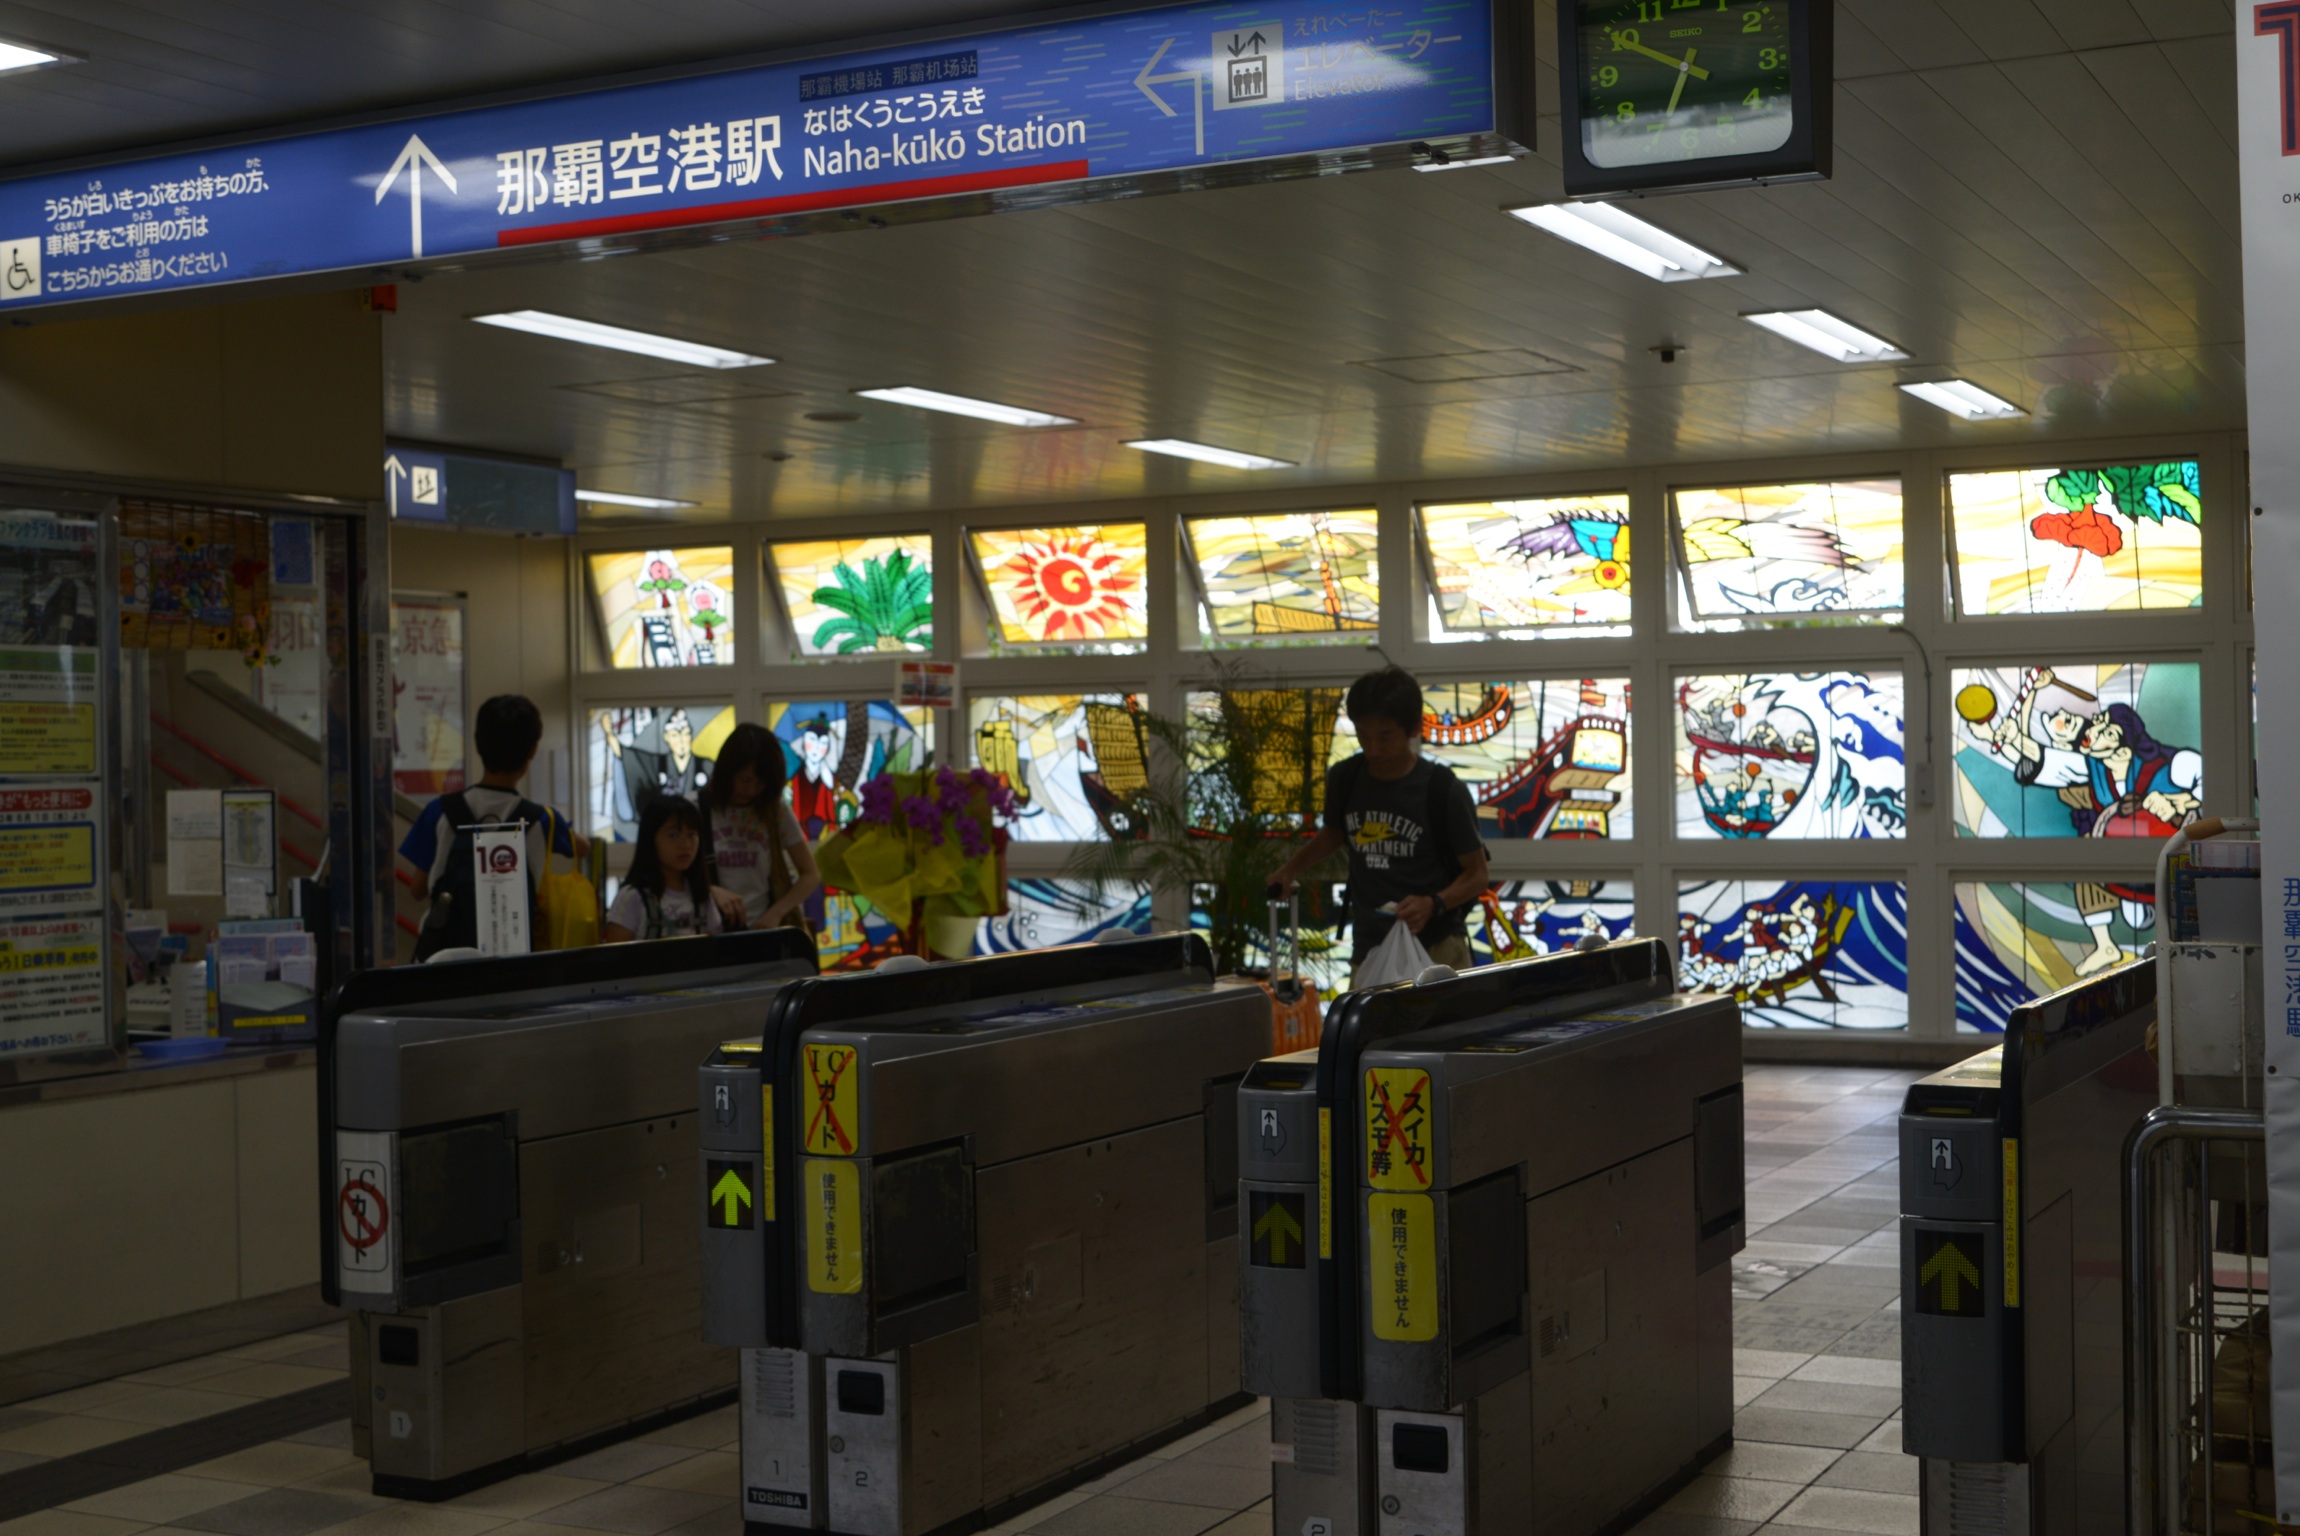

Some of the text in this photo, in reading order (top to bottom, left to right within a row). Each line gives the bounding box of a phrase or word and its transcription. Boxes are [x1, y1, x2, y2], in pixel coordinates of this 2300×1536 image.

[1294, 9, 1403, 37] えれべーたー
[1638, 0, 1664, 23] 11
[1742, 11, 1762, 33] 2
[1611, 28, 1640, 51] 10
[1669, 27, 1703, 39] SEIKO
[1294, 29, 1462, 71] エレベーター
[1759, 48, 1778, 70] 3
[1294, 73, 1385, 101] Elevator
[1599, 65, 1618, 87] 9
[803, 86, 986, 136] なはくうこうえき
[1742, 87, 1763, 110] 4
[1616, 101, 1636, 123] 8
[1647, 124, 1665, 145] 7
[1716, 116, 1736, 137] 5
[803, 115, 1086, 178] Naha-kūkō Station
[496, 115, 783, 216] 那覇空港駅
[44, 169, 270, 222] うらが白いきっぷをお持ちの方、
[45, 214, 209, 258] 車椅子をご利用の方は
[46, 250, 229, 293] こちらからお通りください
[1345, 811, 1362, 832] HE
[811, 1049, 846, 1074] IC
[819, 1079, 836, 1149] カード
[1370, 1080, 1392, 1177] パスモ等
[1404, 1089, 1425, 1166] スイカ
[345, 1167, 376, 1193] IC
[352, 1194, 367, 1265] カード
[822, 1172, 838, 1282] 使用できません
[1391, 1207, 1410, 1329] 使用できません
[397, 1416, 403, 1432] 1
[773, 1459, 779, 1475] 1
[855, 1471, 868, 1487] 2
[750, 1490, 803, 1507] TOSHIBA
